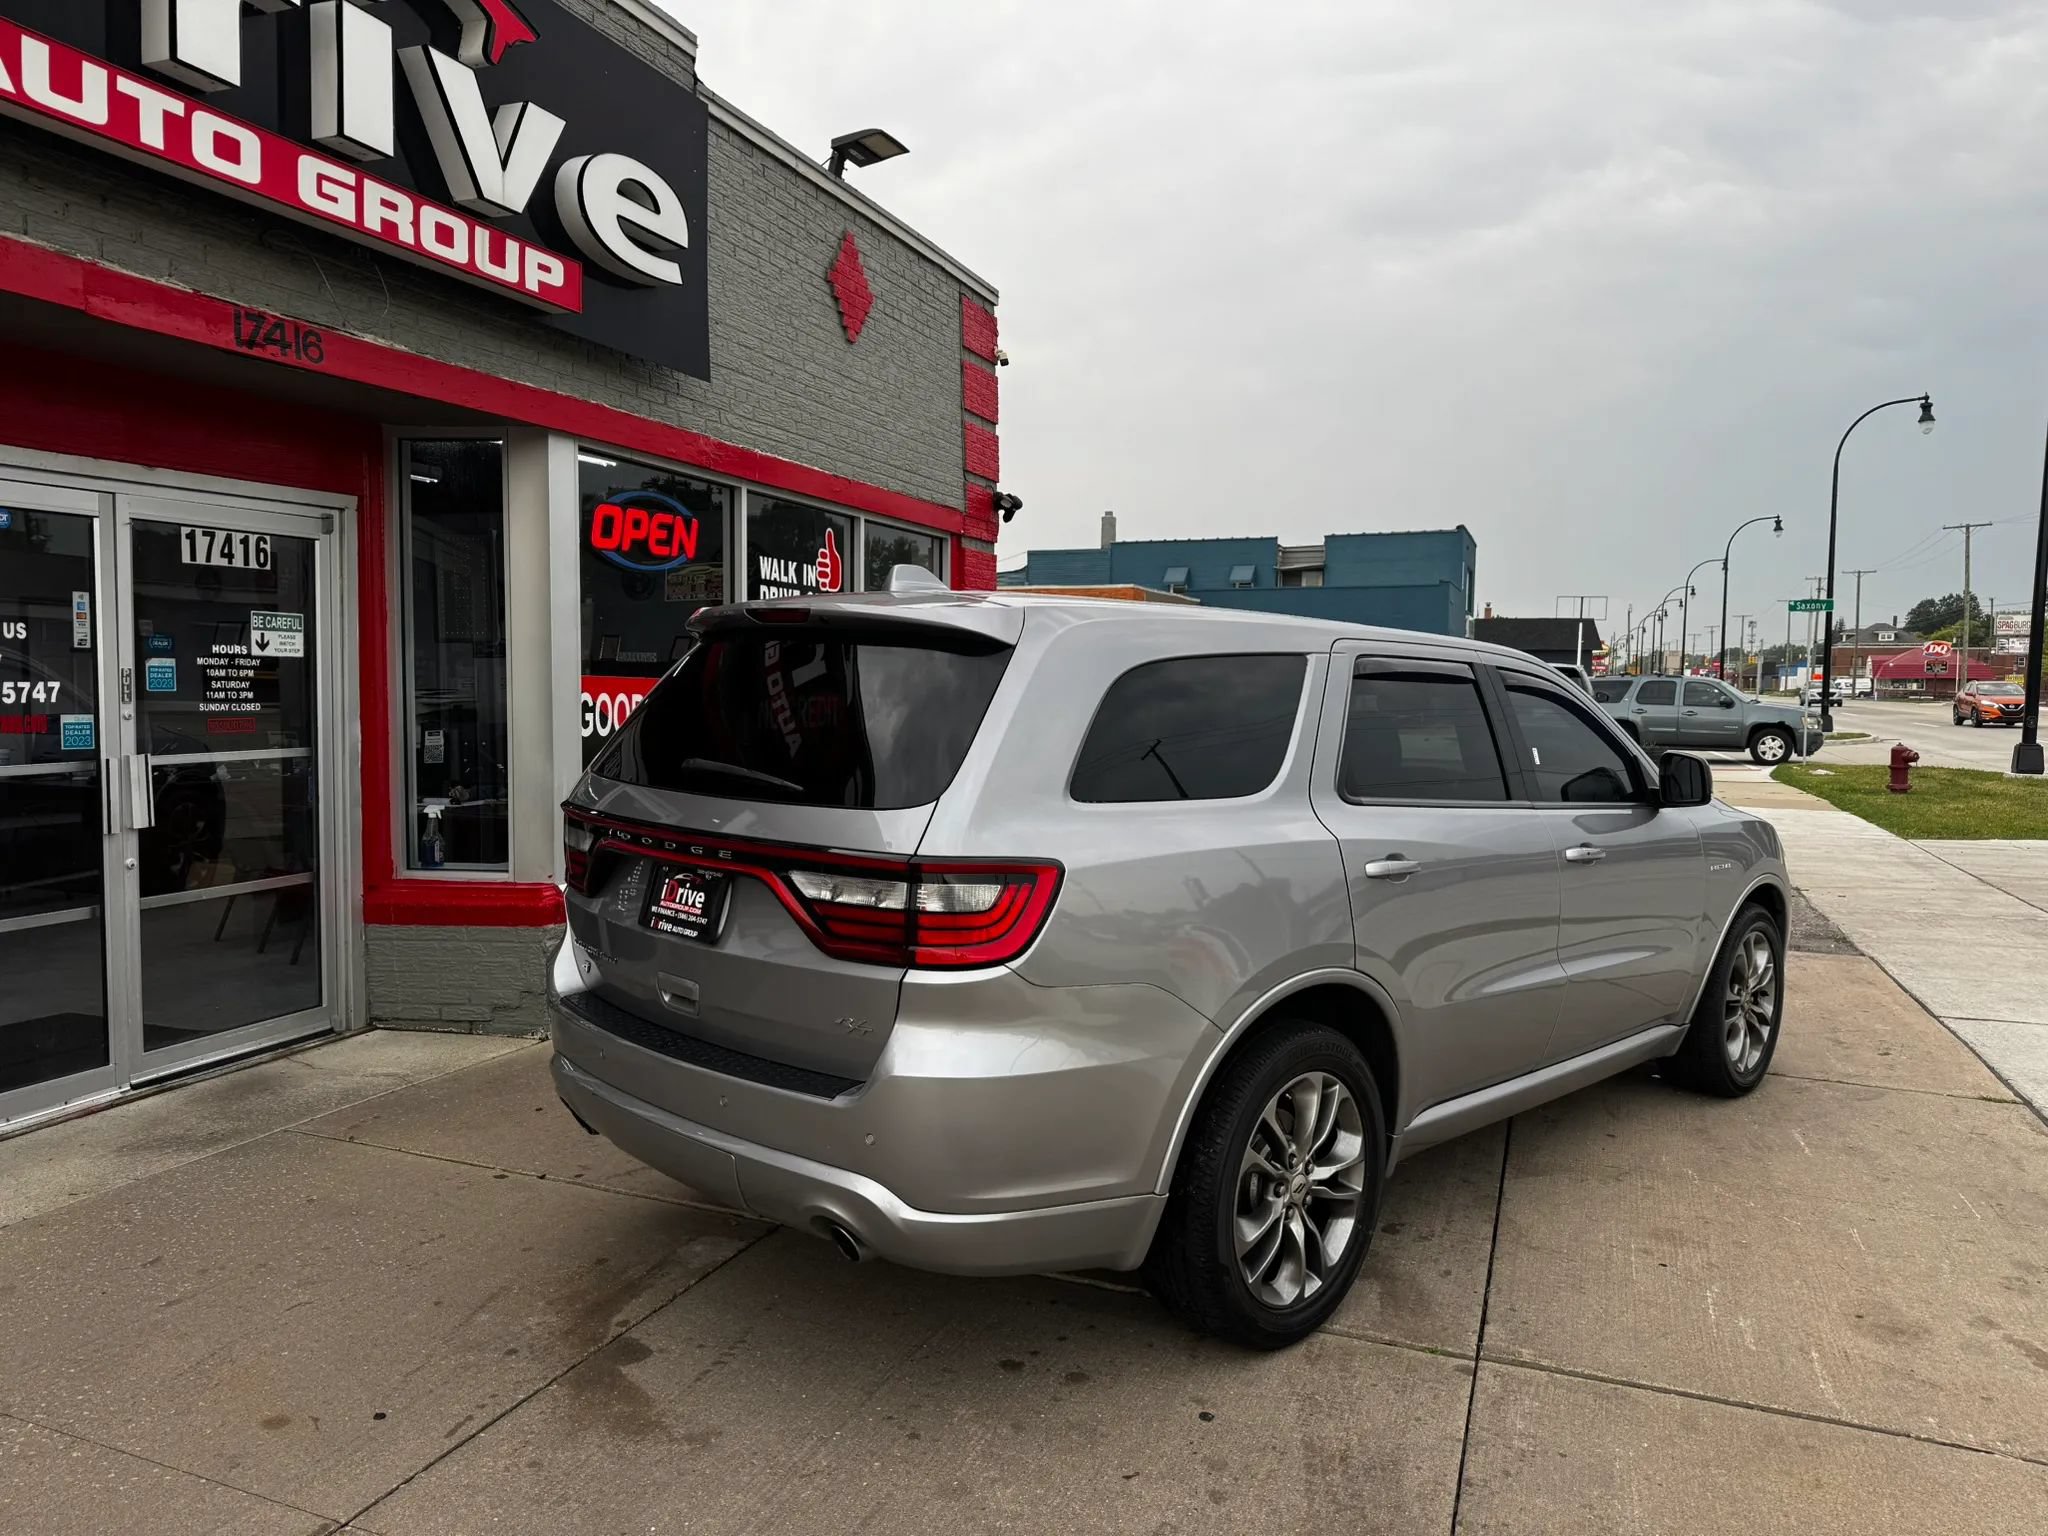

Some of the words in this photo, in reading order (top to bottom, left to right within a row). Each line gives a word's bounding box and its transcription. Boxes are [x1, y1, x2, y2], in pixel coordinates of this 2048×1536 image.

[297, 154, 565, 293] GROUP
[233, 308, 325, 364] 17416
[591, 503, 699, 560] OPEN
[185, 528, 270, 569] 17416
[759, 555, 798, 584] WALK
[803, 563, 816, 587] IN
[1796, 601, 1827, 610] Saxony
[253, 615, 264, 628] BE
[266, 616, 302, 630] CAREFUL
[3, 621, 27, 639] US
[212, 644, 248, 655] HOURS
[1928, 644, 1948, 654] DQ
[197, 657, 229, 665] MONDAY
[235, 658, 261, 666] FRIDAY
[206, 668, 226, 677] 10AM
[228, 669, 238, 677] TO
[239, 669, 254, 677] 6PM
[150, 679, 173, 688] 2023
[211, 681, 250, 689] SATURDAY
[1, 681, 61, 704] 5747
[206, 690, 226, 699] 11AM
[227, 691, 237, 699] TO
[239, 691, 254, 699] 3PM
[199, 703, 229, 711] SUNDAY
[231, 702, 261, 711] CLOSED
[65, 736, 91, 745] 2023
[619, 831, 732, 859] DODGE
[661, 878, 705, 908] iDrive
